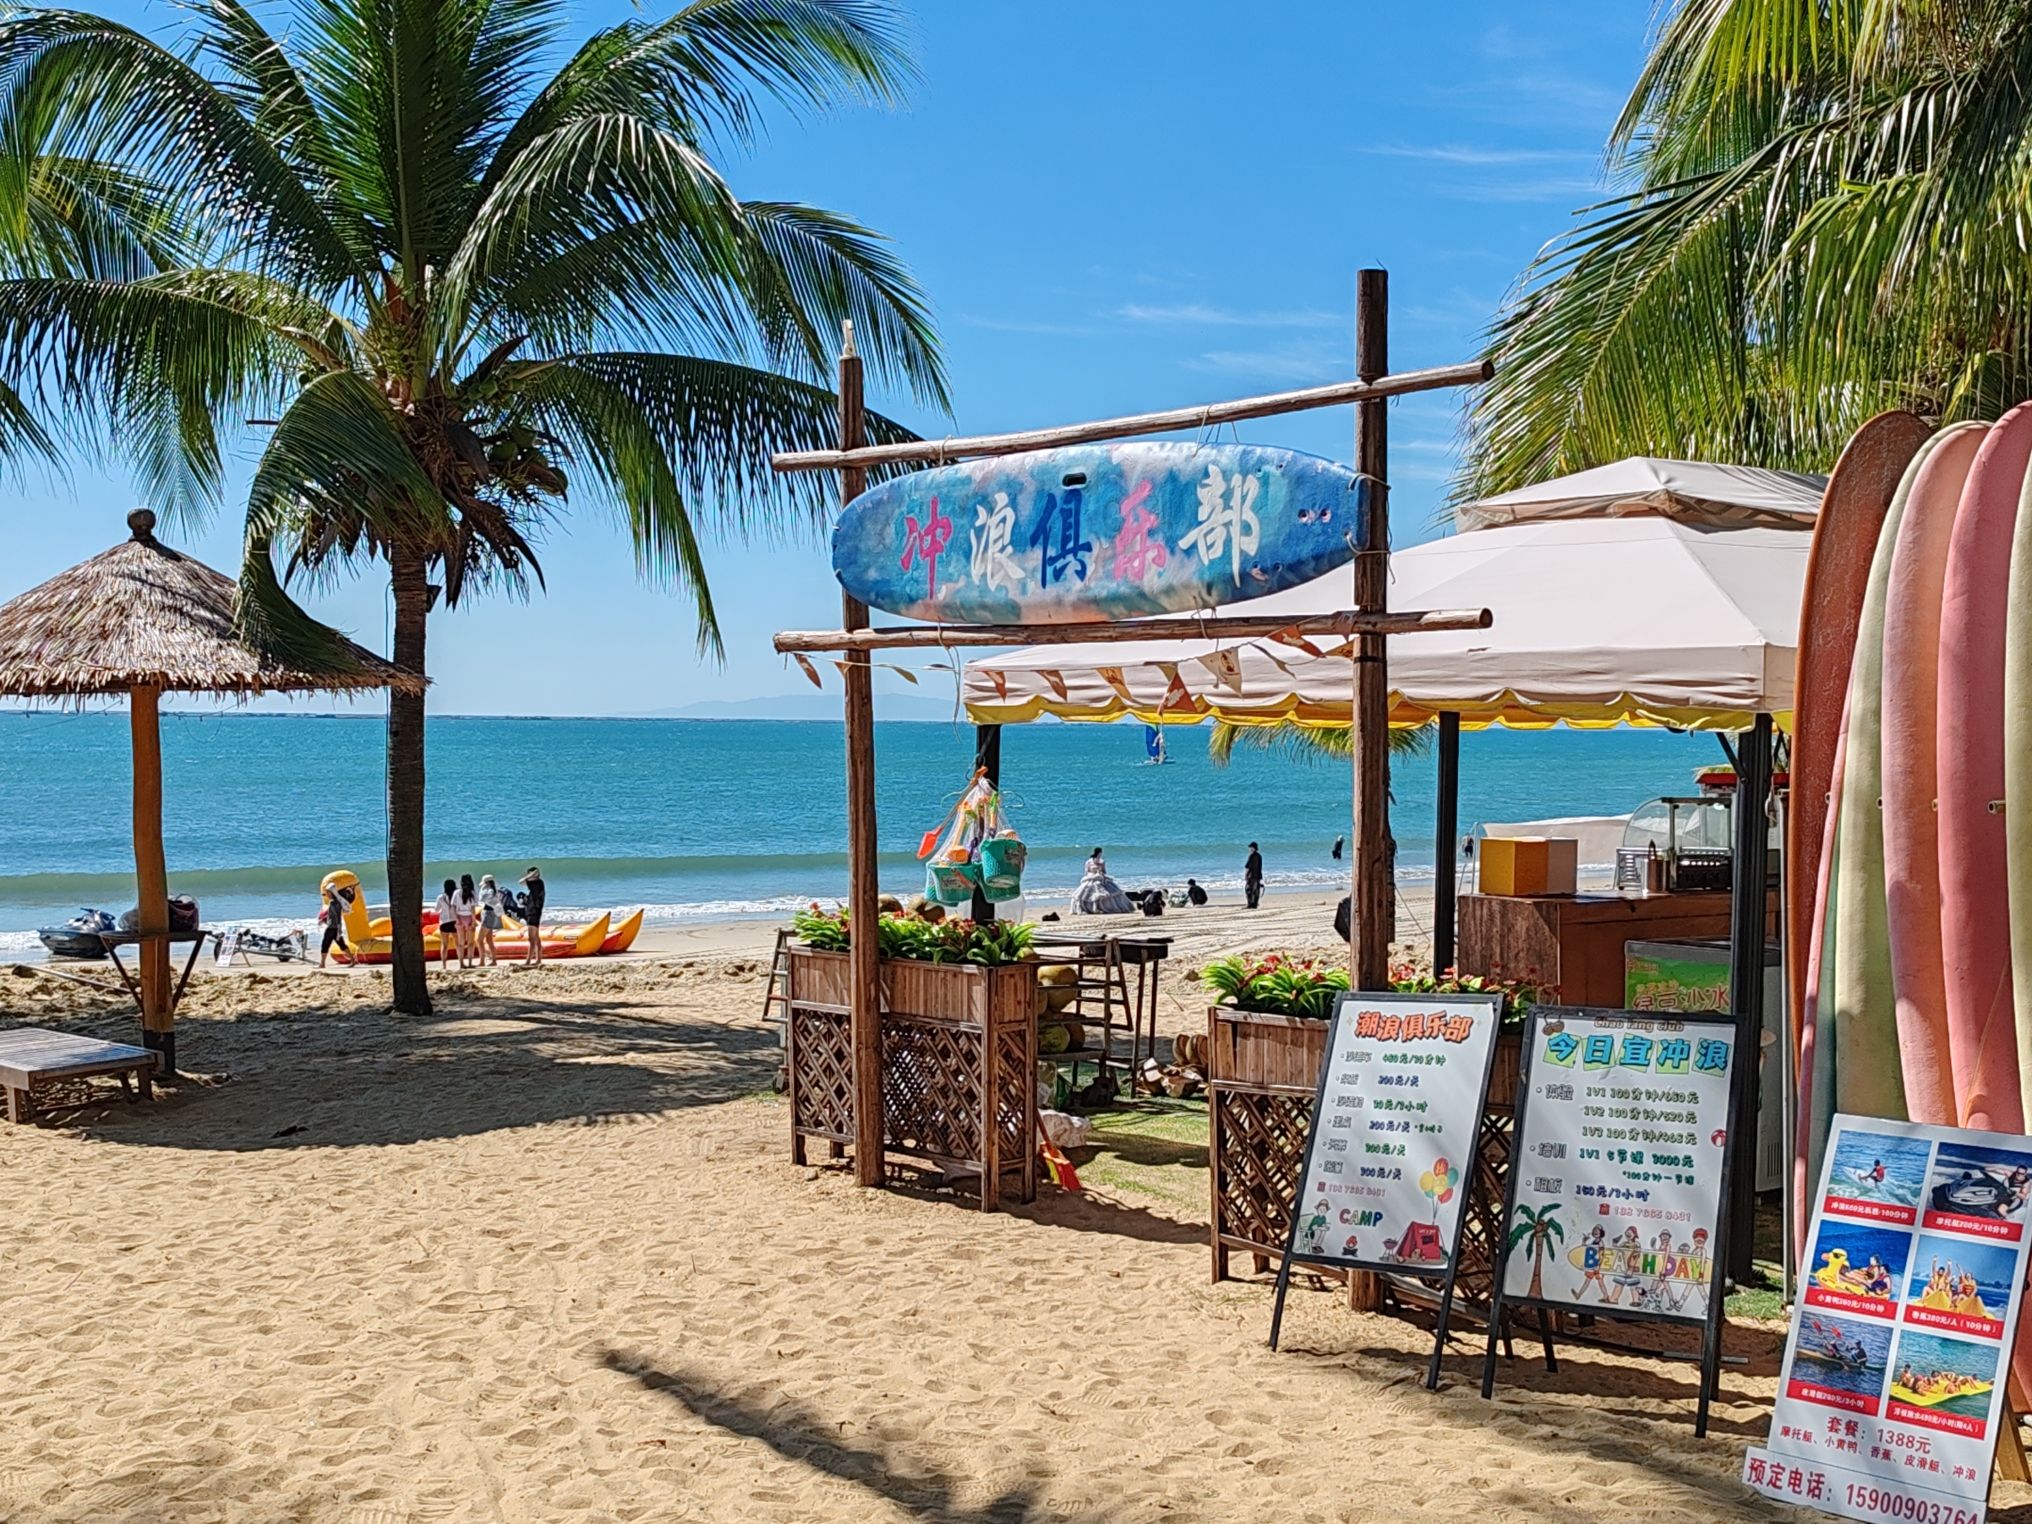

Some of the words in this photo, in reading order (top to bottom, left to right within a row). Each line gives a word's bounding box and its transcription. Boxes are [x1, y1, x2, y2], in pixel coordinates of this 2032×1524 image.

[900, 464, 1260, 600] 冲浪俱乐部
[1355, 1010, 1473, 1043] 潮浪俱乐部
[1548, 1032, 1729, 1070] 今日宜冲浪
[1538, 1142, 1567, 1160] 培训
[1339, 1208, 1383, 1227] CAMP
